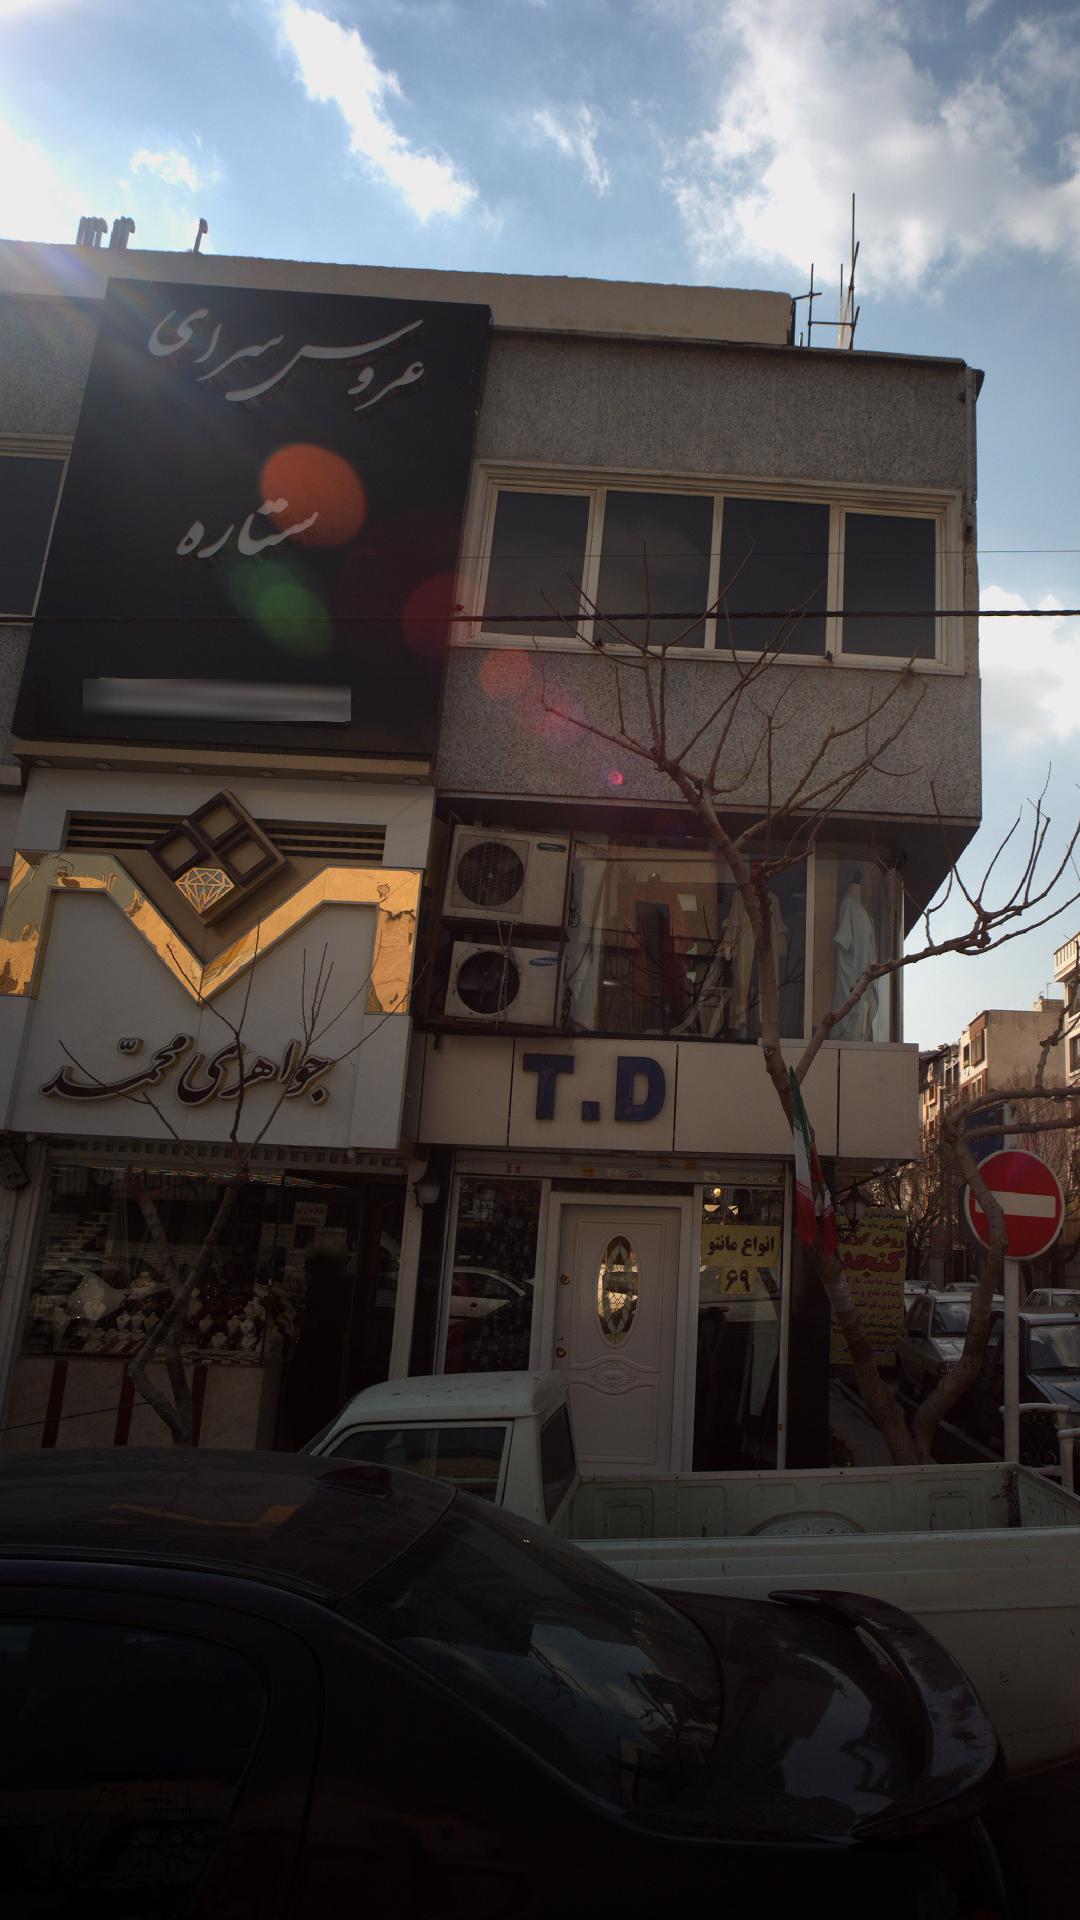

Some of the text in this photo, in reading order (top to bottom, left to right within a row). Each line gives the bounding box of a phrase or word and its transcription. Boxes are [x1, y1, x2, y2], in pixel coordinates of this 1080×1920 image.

[148, 308, 285, 382] سرای
[176, 498, 319, 559] ستاره
[176, 1040, 338, 1105] جواهری
[522, 1053, 666, 1121] T.D
[706, 1234, 775, 1257] انواع مانتو
[725, 1269, 750, 1292] ۶۹
